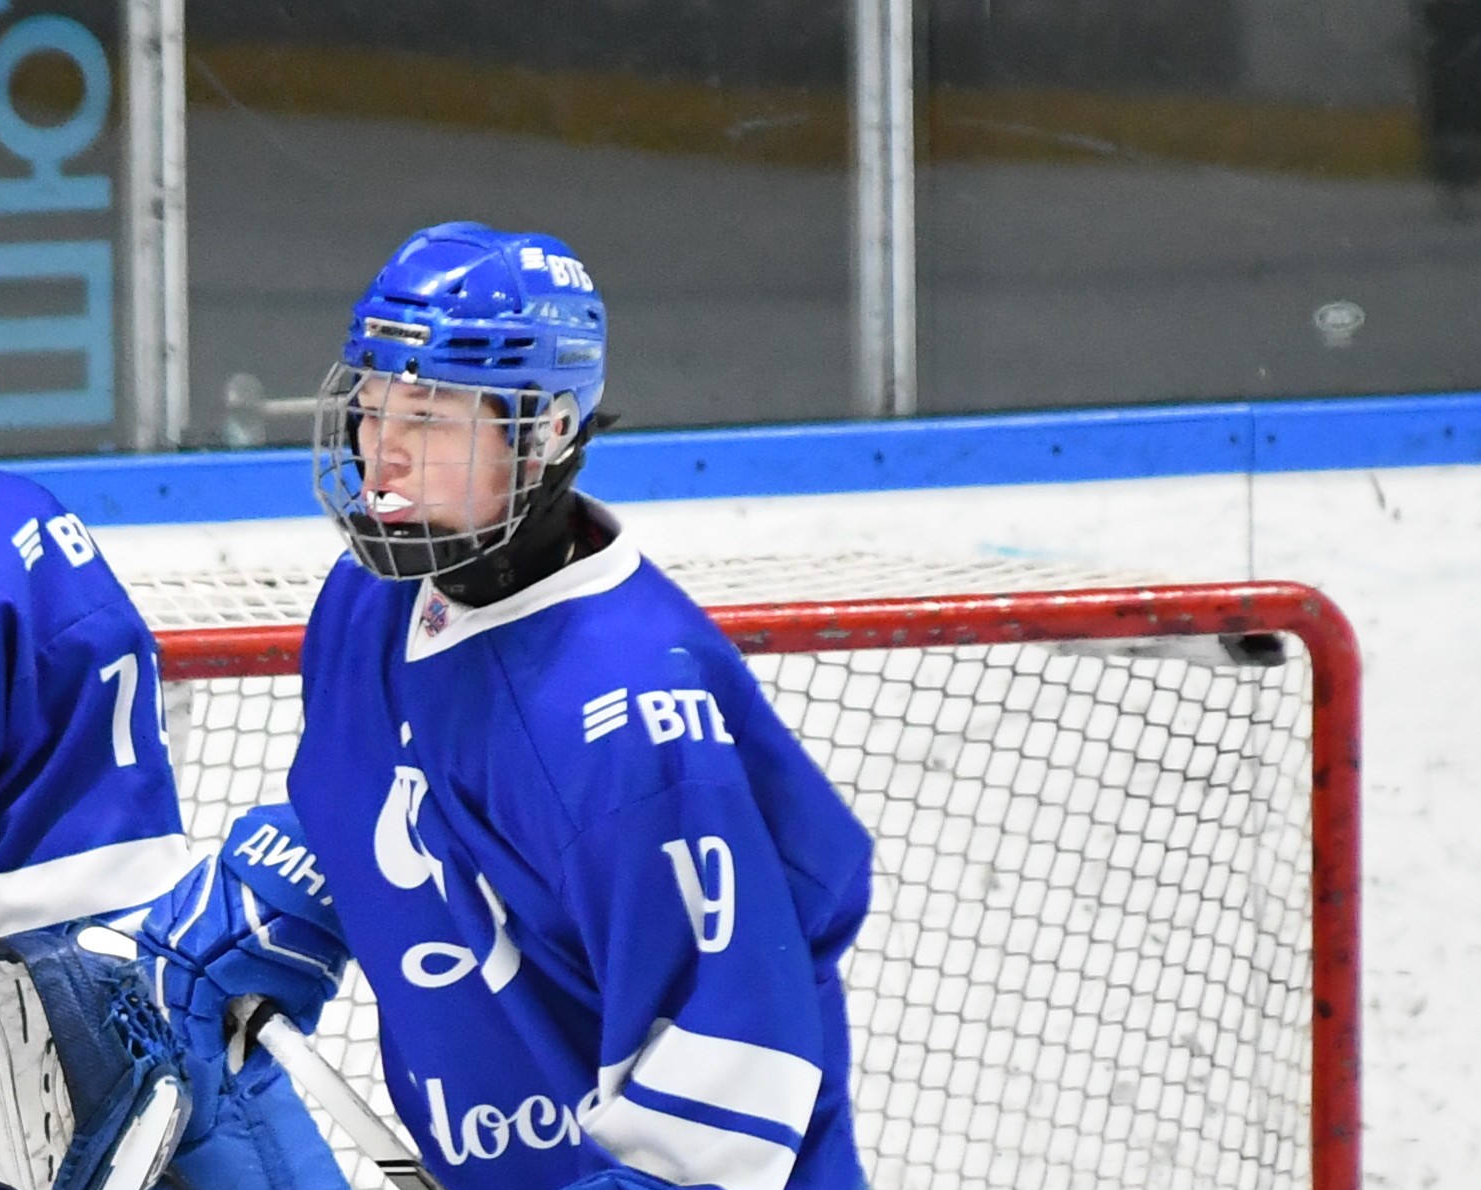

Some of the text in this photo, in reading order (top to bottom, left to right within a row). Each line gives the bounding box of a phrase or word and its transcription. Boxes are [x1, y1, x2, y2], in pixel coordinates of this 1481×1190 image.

[545, 253, 595, 293] ВТБ
[99, 652, 174, 768] 7
[233, 823, 334, 906] ДИН
[662, 836, 736, 953] 19
